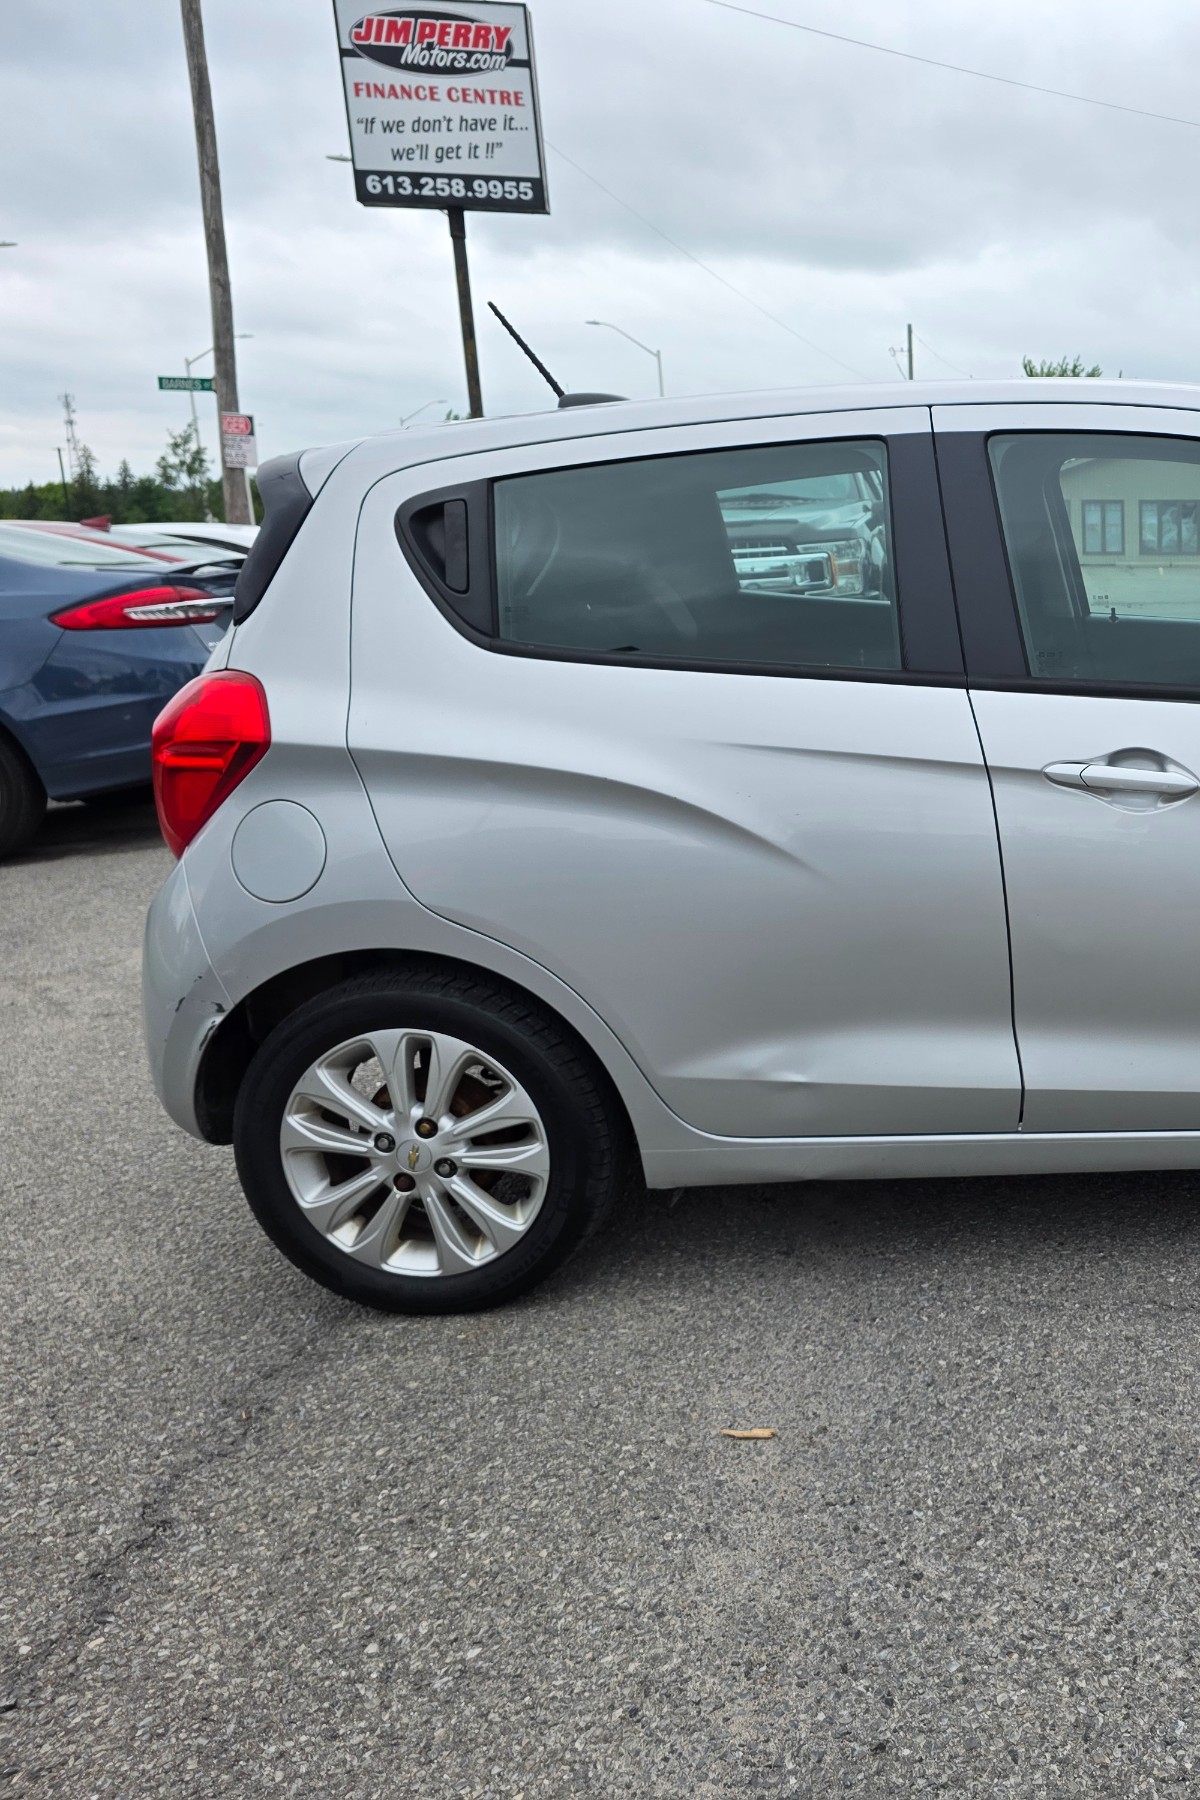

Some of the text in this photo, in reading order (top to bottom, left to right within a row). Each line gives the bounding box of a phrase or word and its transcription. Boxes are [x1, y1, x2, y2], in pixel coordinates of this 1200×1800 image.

[353, 17, 513, 51] JIM PERRY
[400, 43, 507, 71] Motors.com
[353, 82, 526, 107] FINANCE CENTRE
[381, 119, 405, 134] we
[411, 115, 453, 133] don't
[459, 115, 497, 132] have
[503, 114, 529, 131] it...
[391, 144, 429, 161] we'll
[435, 144, 462, 163] get
[468, 142, 480, 159] it
[365, 174, 534, 200] 613.258.9955
